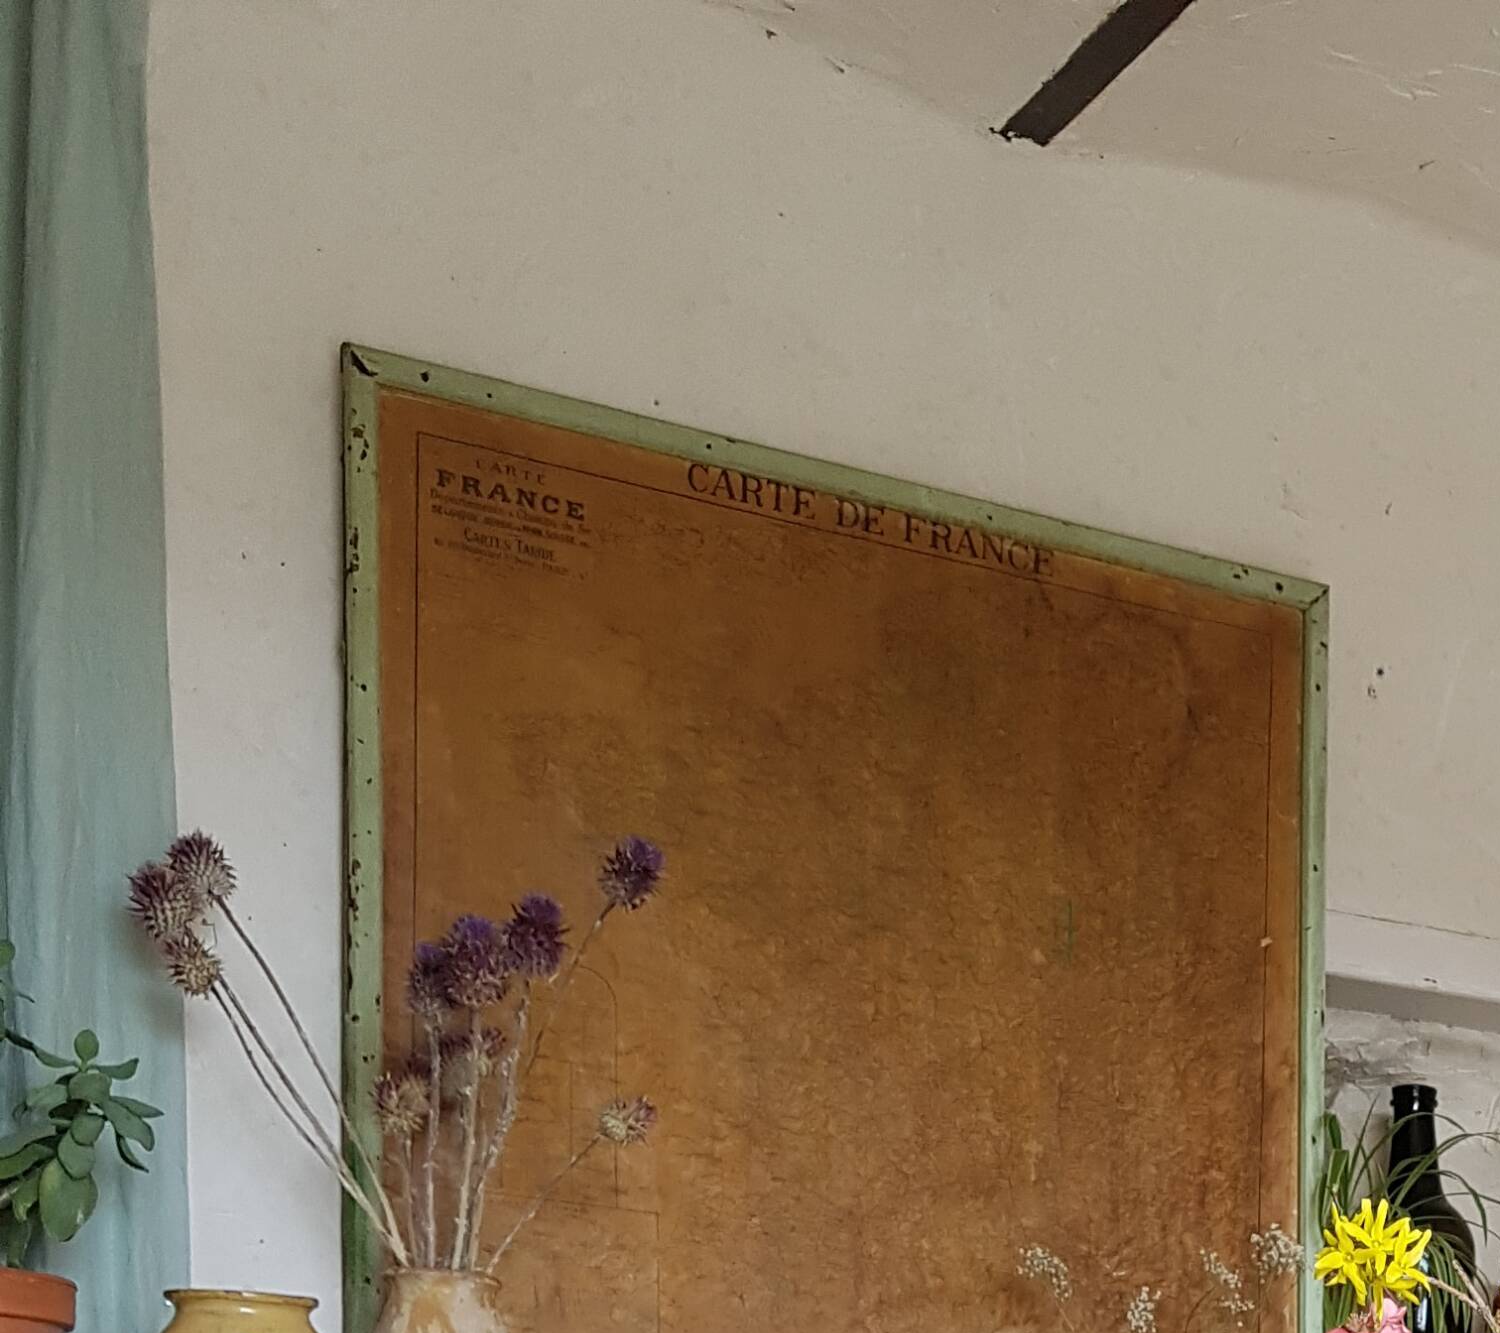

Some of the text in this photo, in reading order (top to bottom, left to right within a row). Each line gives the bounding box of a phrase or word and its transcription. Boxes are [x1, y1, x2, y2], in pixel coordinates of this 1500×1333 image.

[435, 468, 586, 522] FRANCE
[687, 463, 1055, 578] CARTE DE FRANCE
